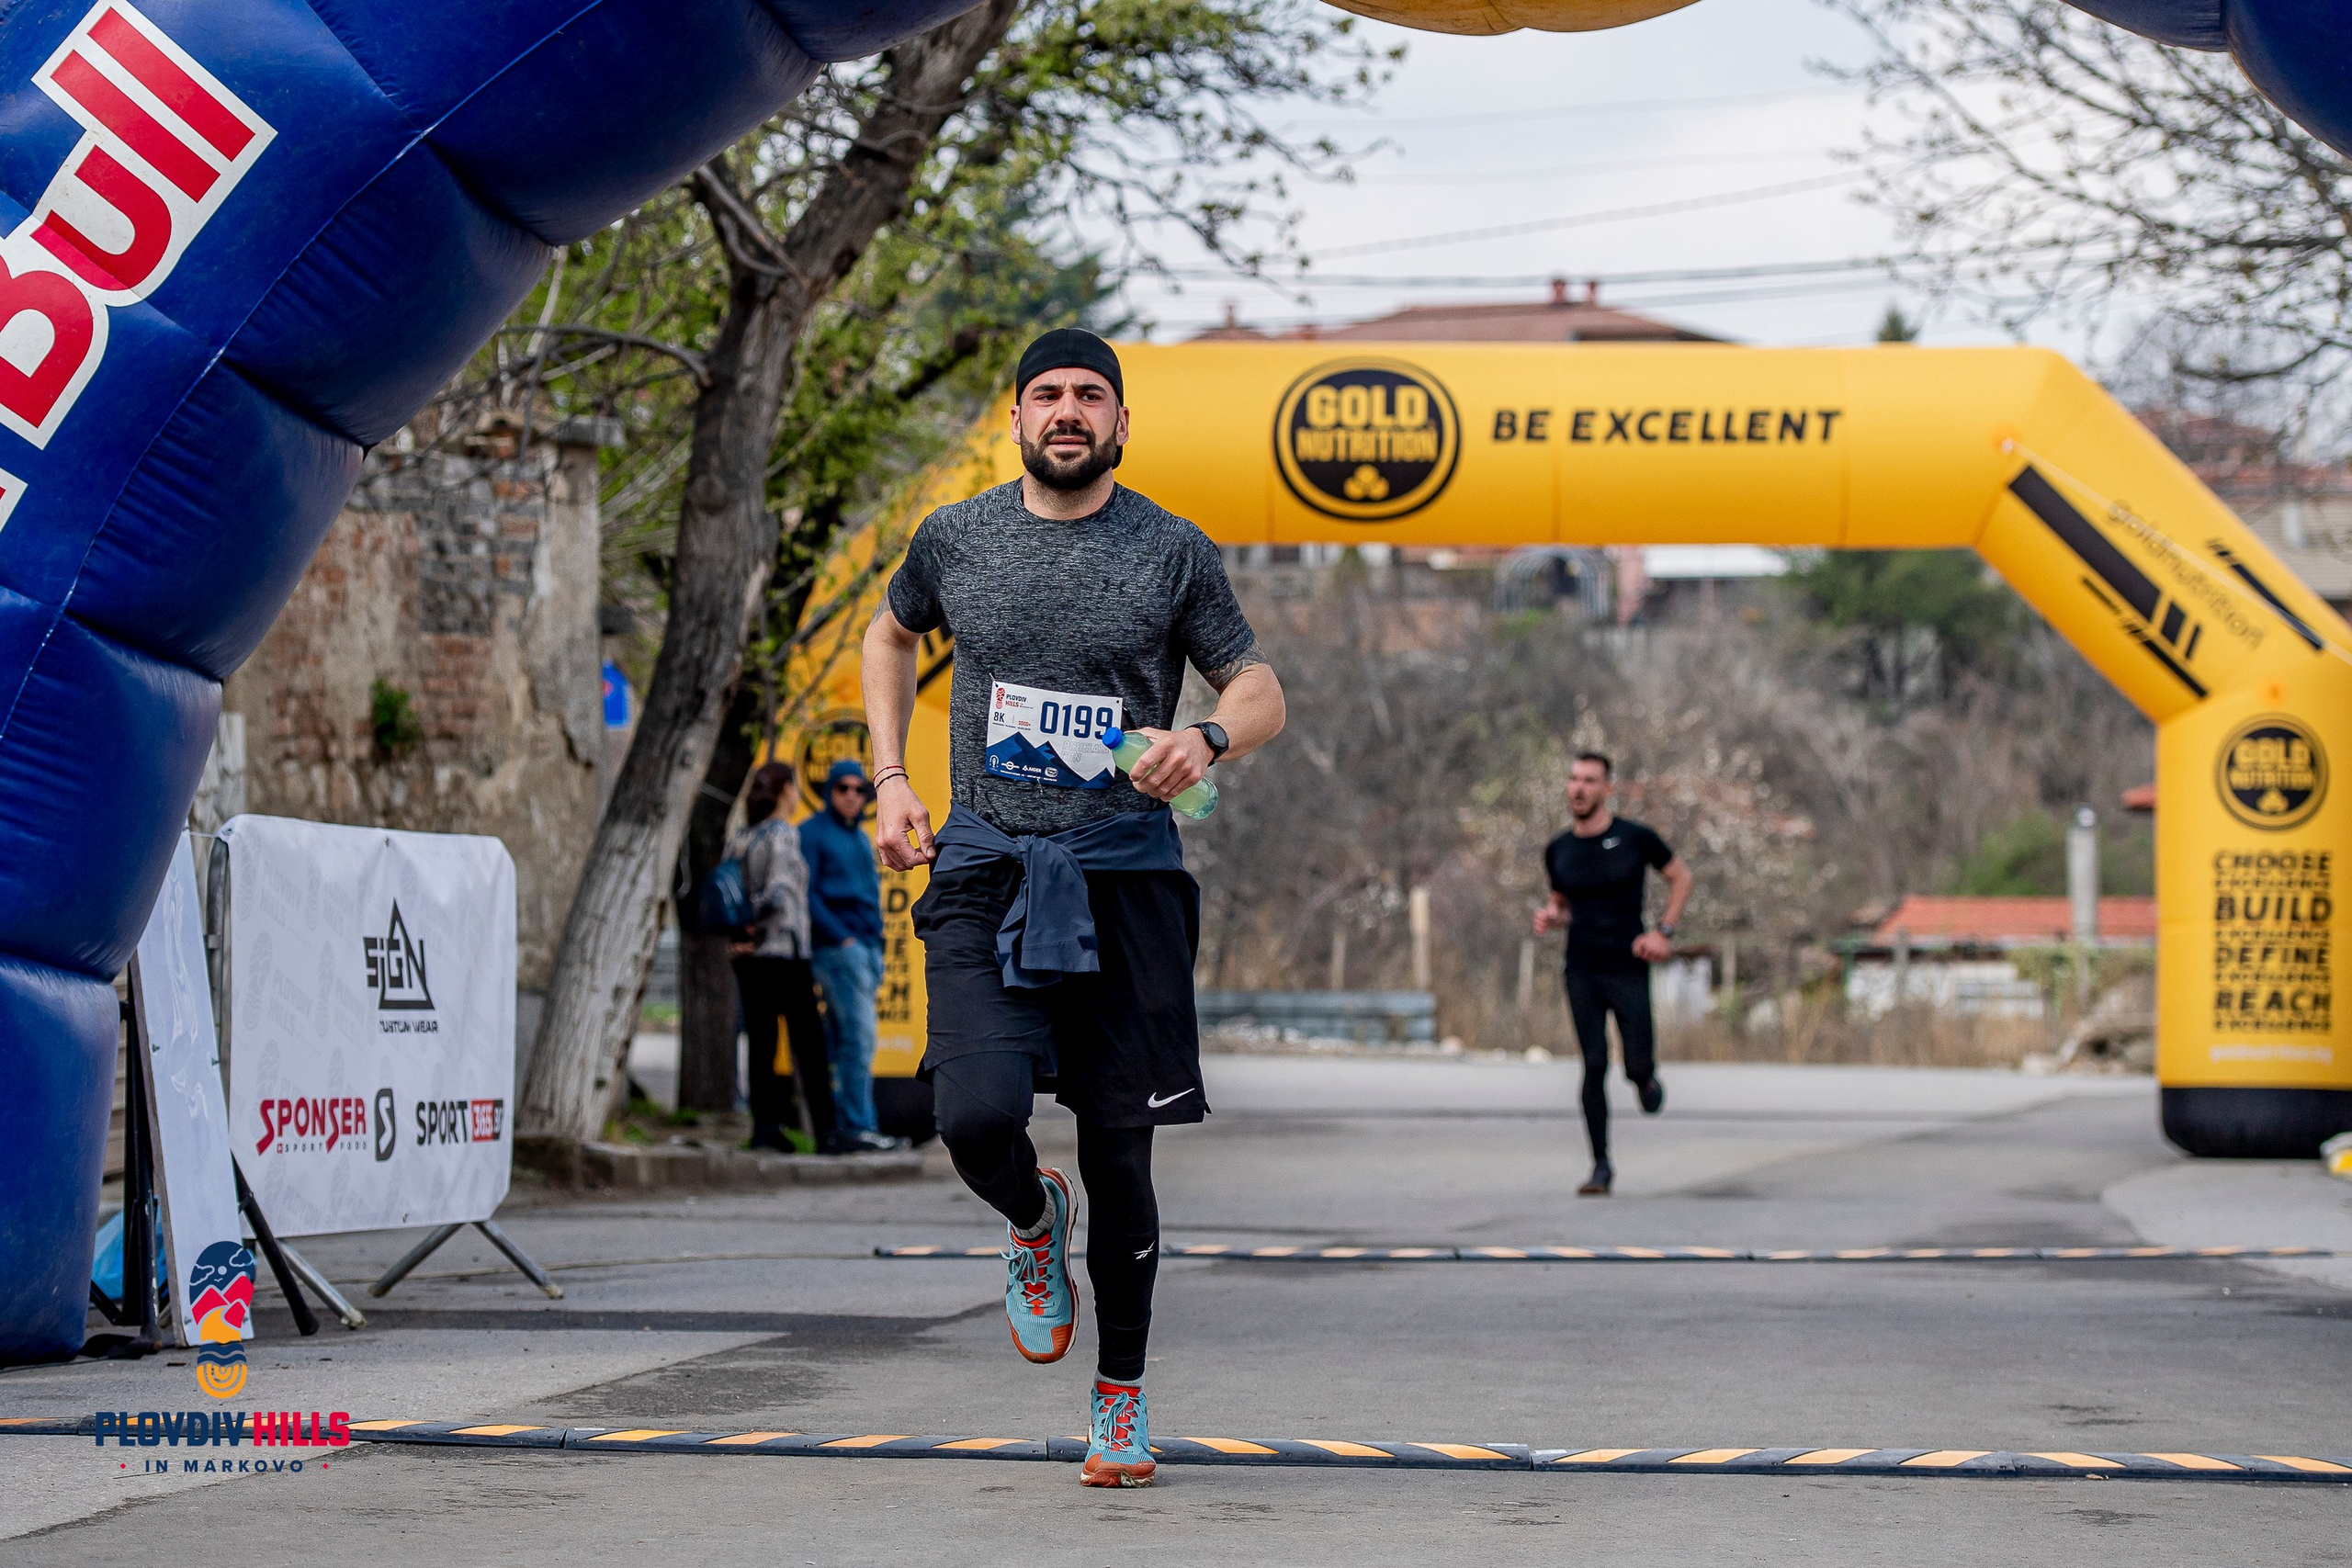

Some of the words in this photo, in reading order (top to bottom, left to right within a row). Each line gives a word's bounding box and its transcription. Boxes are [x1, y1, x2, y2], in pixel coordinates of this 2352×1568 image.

[1306, 384, 1430, 429] GOLD
[1493, 409, 1552, 443] BE
[1569, 409, 1843, 443] EXCELLENT
[1296, 428, 1439, 462] NUTRITION
[1006, 694, 1027, 703] PLOVDIV
[993, 711, 1005, 723] 8K
[1040, 701, 1114, 739] 0199
[2212, 851, 2331, 874] CHOOSE
[2212, 894, 2333, 923] BUILD
[2212, 943, 2331, 967] DEFINE
[2212, 988, 2332, 1014] REACH
[256, 1097, 367, 1156] SPONSER
